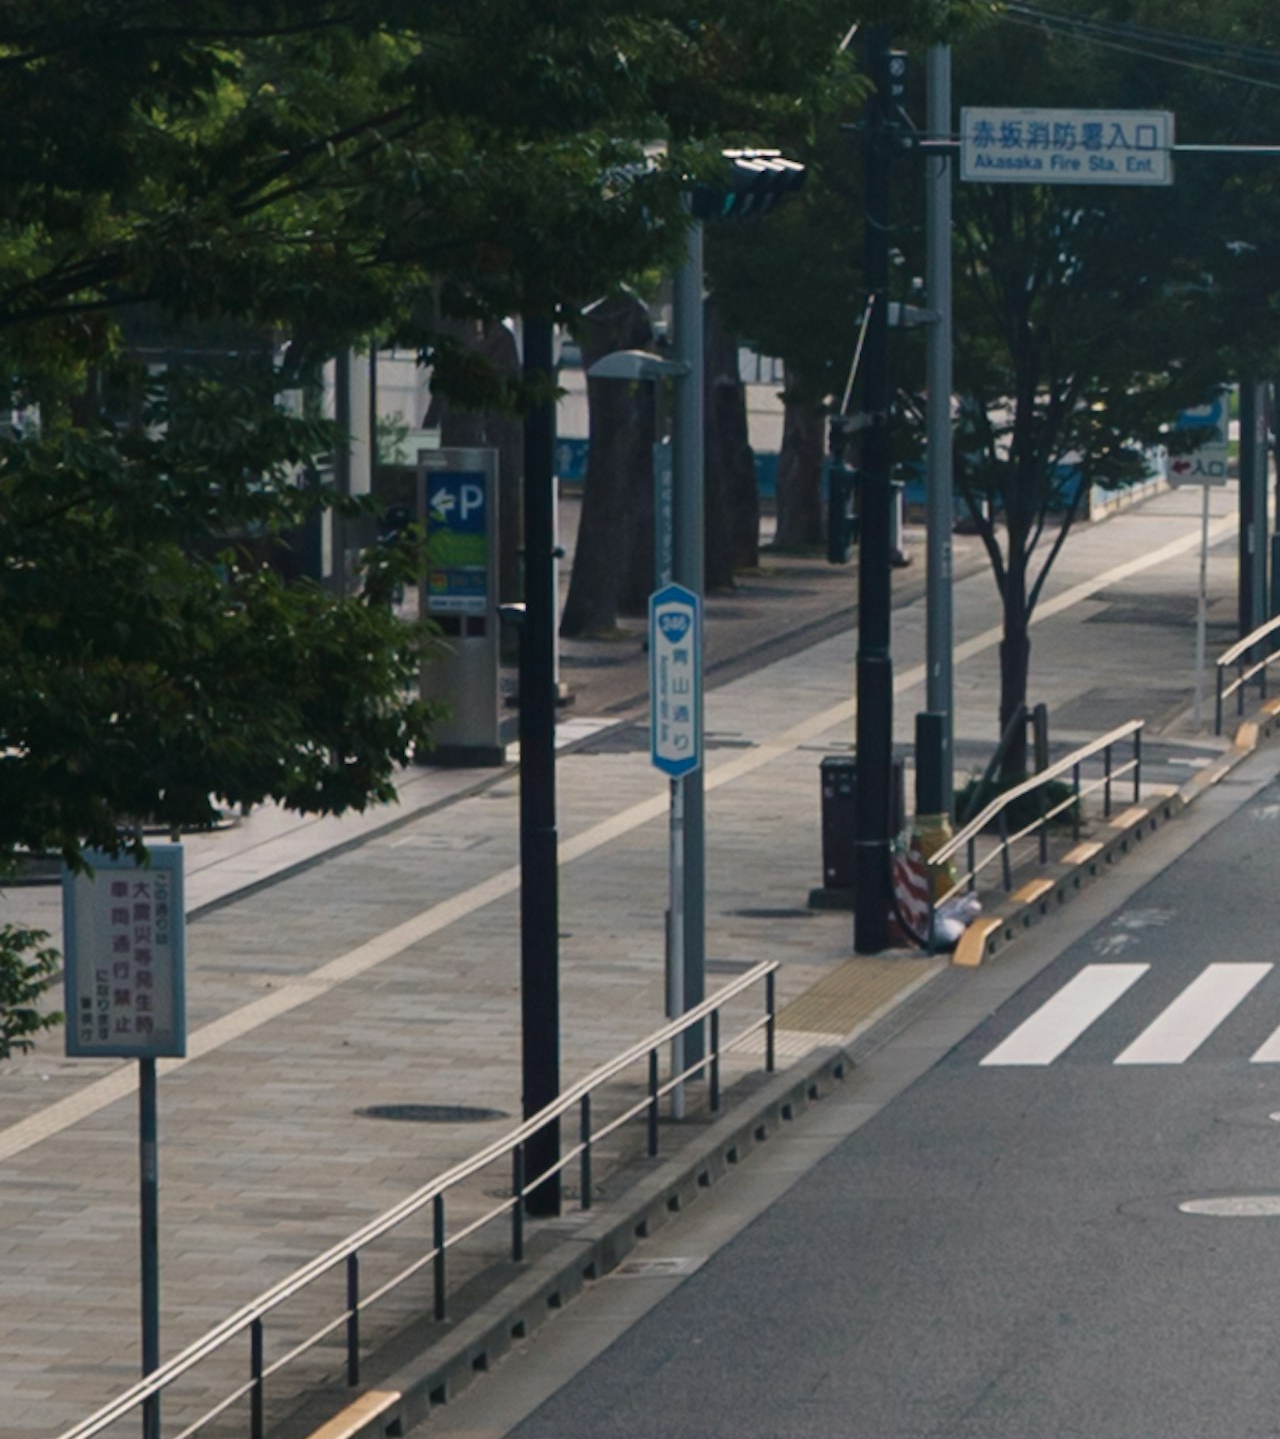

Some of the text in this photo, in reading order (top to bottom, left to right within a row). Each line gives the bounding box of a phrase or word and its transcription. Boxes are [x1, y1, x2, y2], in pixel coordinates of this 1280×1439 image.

[973, 119, 1158, 150] 赤坂消防署入口
[973, 155, 1154, 172] Akasaka Fire Sta. Ent.
[1191, 459, 1224, 476] 入口
[461, 485, 483, 520] P
[672, 649, 690, 750] 青山通り
